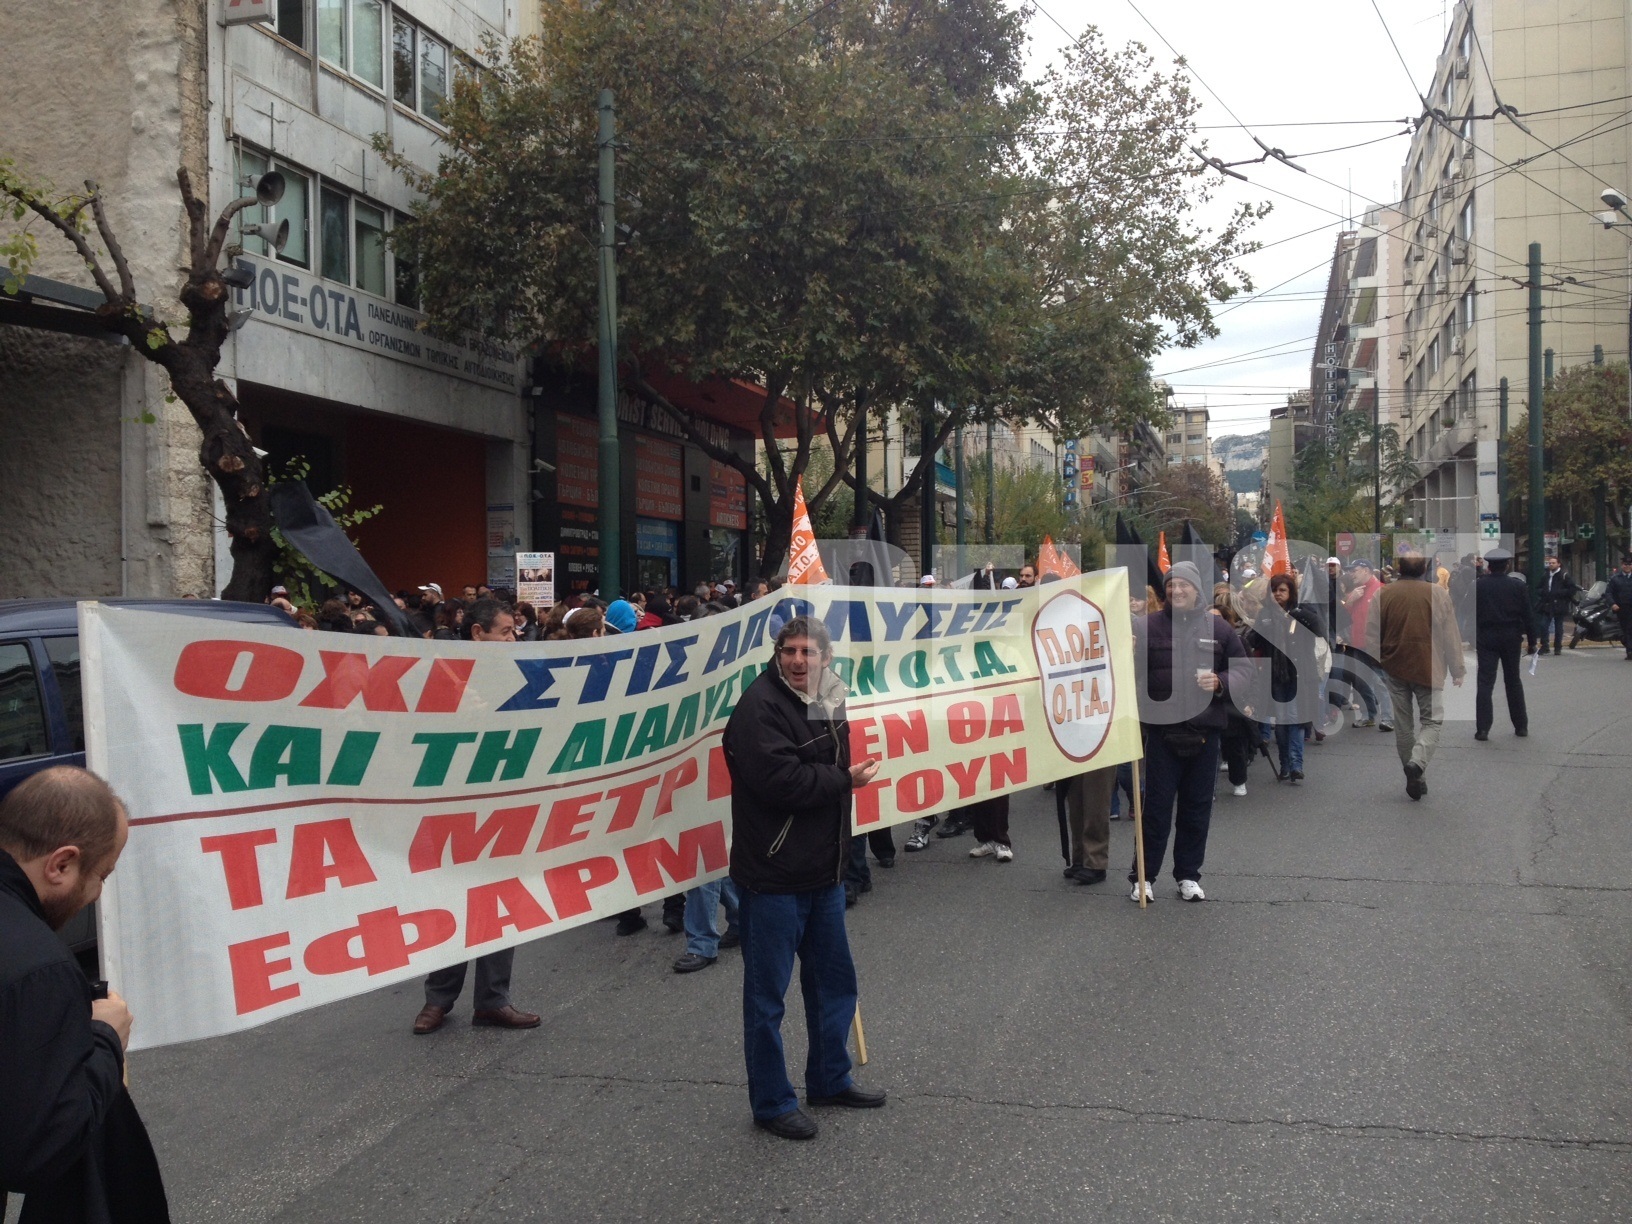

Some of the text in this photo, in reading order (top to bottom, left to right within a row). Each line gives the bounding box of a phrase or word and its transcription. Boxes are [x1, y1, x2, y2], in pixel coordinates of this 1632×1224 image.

[369, 330, 421, 358] ΟΡΓΑΝΙΣΜΩΝ
[1326, 344, 1337, 404] HOTEL
[173, 597, 1024, 713] ΟΧΙ ΣΤΙΣ ΑΠΟΛΥΣΕΙΣ
[177, 722, 381, 795] ΚΑΙ
[412, 727, 542, 787] ΤΗ
[832, 654, 890, 698] ΩΝ
[899, 640, 1018, 690] Ο.Τ.Α.
[1052, 677, 1110, 725] Ο.Τ.Α.
[200, 818, 377, 910] ΤΑ
[848, 709, 929, 769] ΕΝ
[946, 693, 1024, 745] ΘΑ
